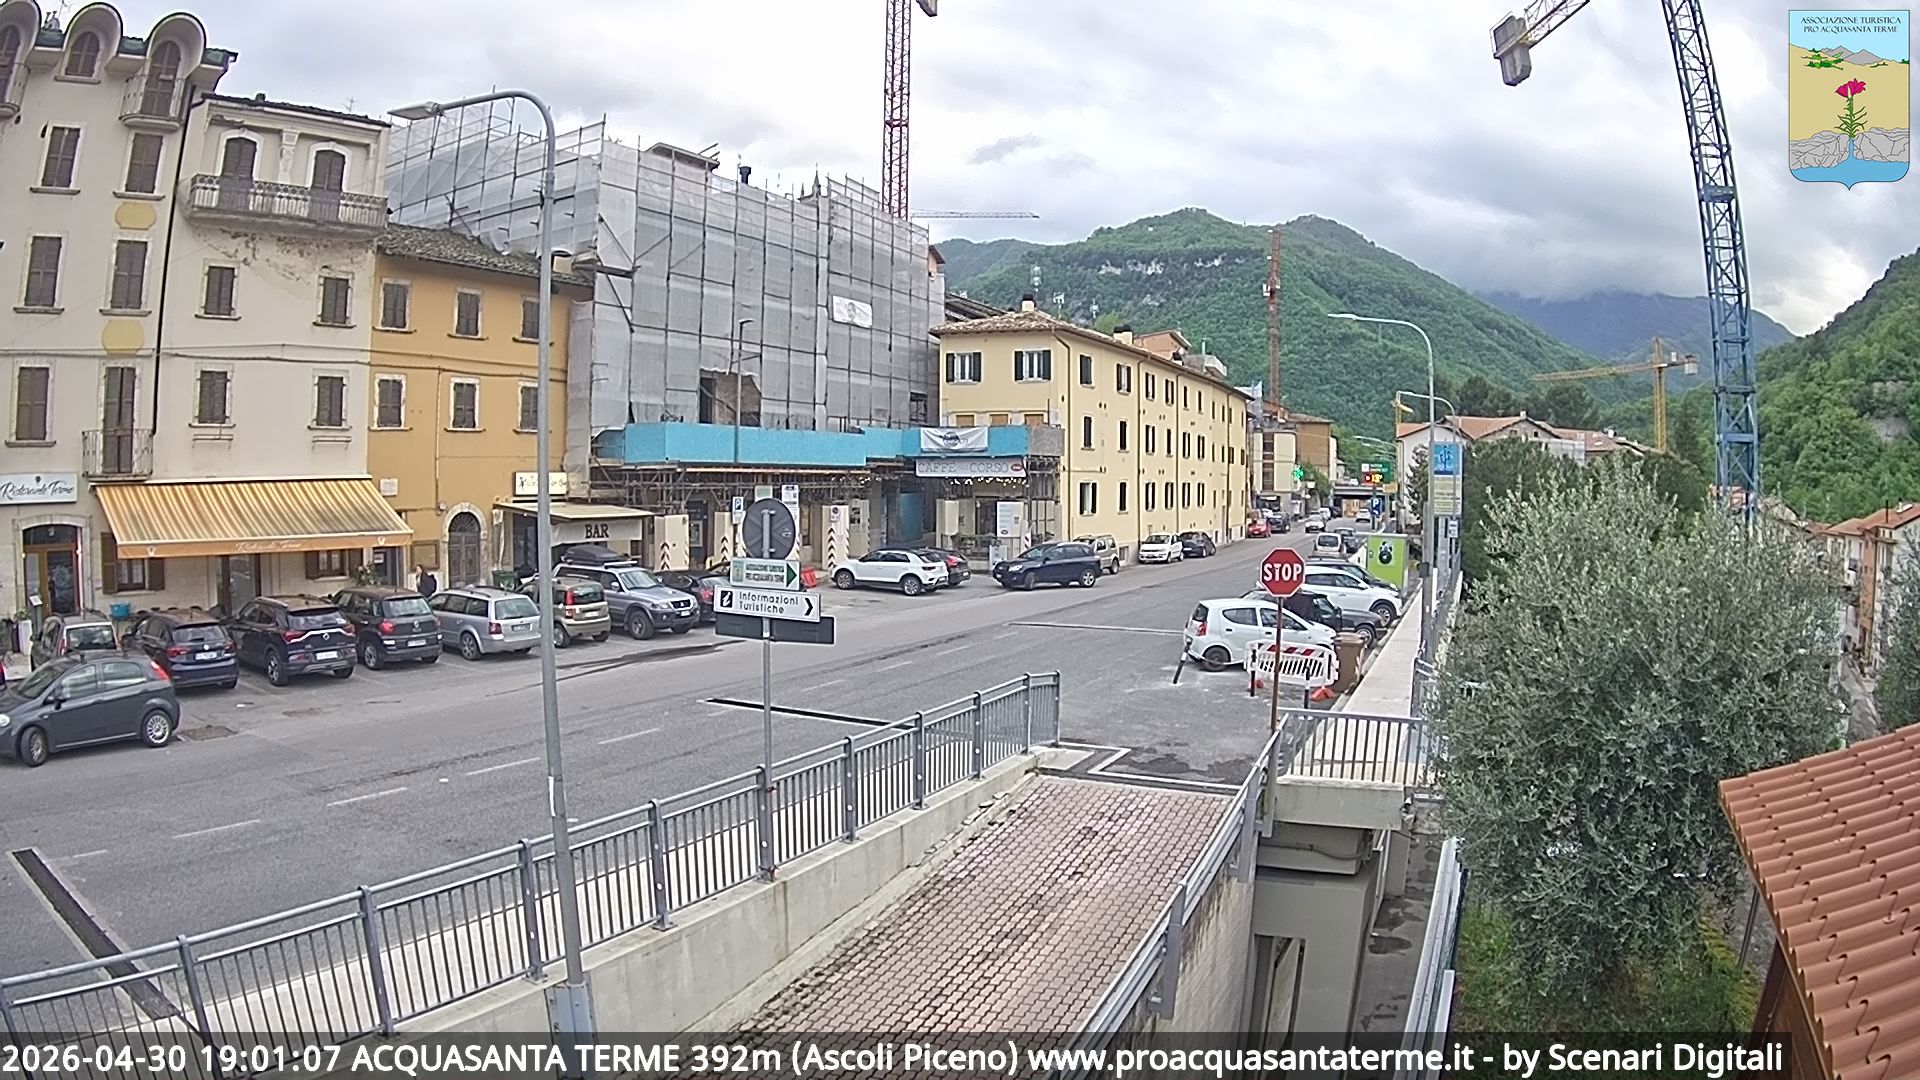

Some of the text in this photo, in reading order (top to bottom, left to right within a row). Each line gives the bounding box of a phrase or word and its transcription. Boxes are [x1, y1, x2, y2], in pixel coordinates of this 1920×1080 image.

[969, 462, 1009, 473] CORSO
[1373, 498, 1380, 508] P
[585, 524, 609, 539] BAR
[1263, 563, 1302, 582] STOP
[739, 592, 799, 605] Informazioni
[739, 601, 784, 614] Turistiche
